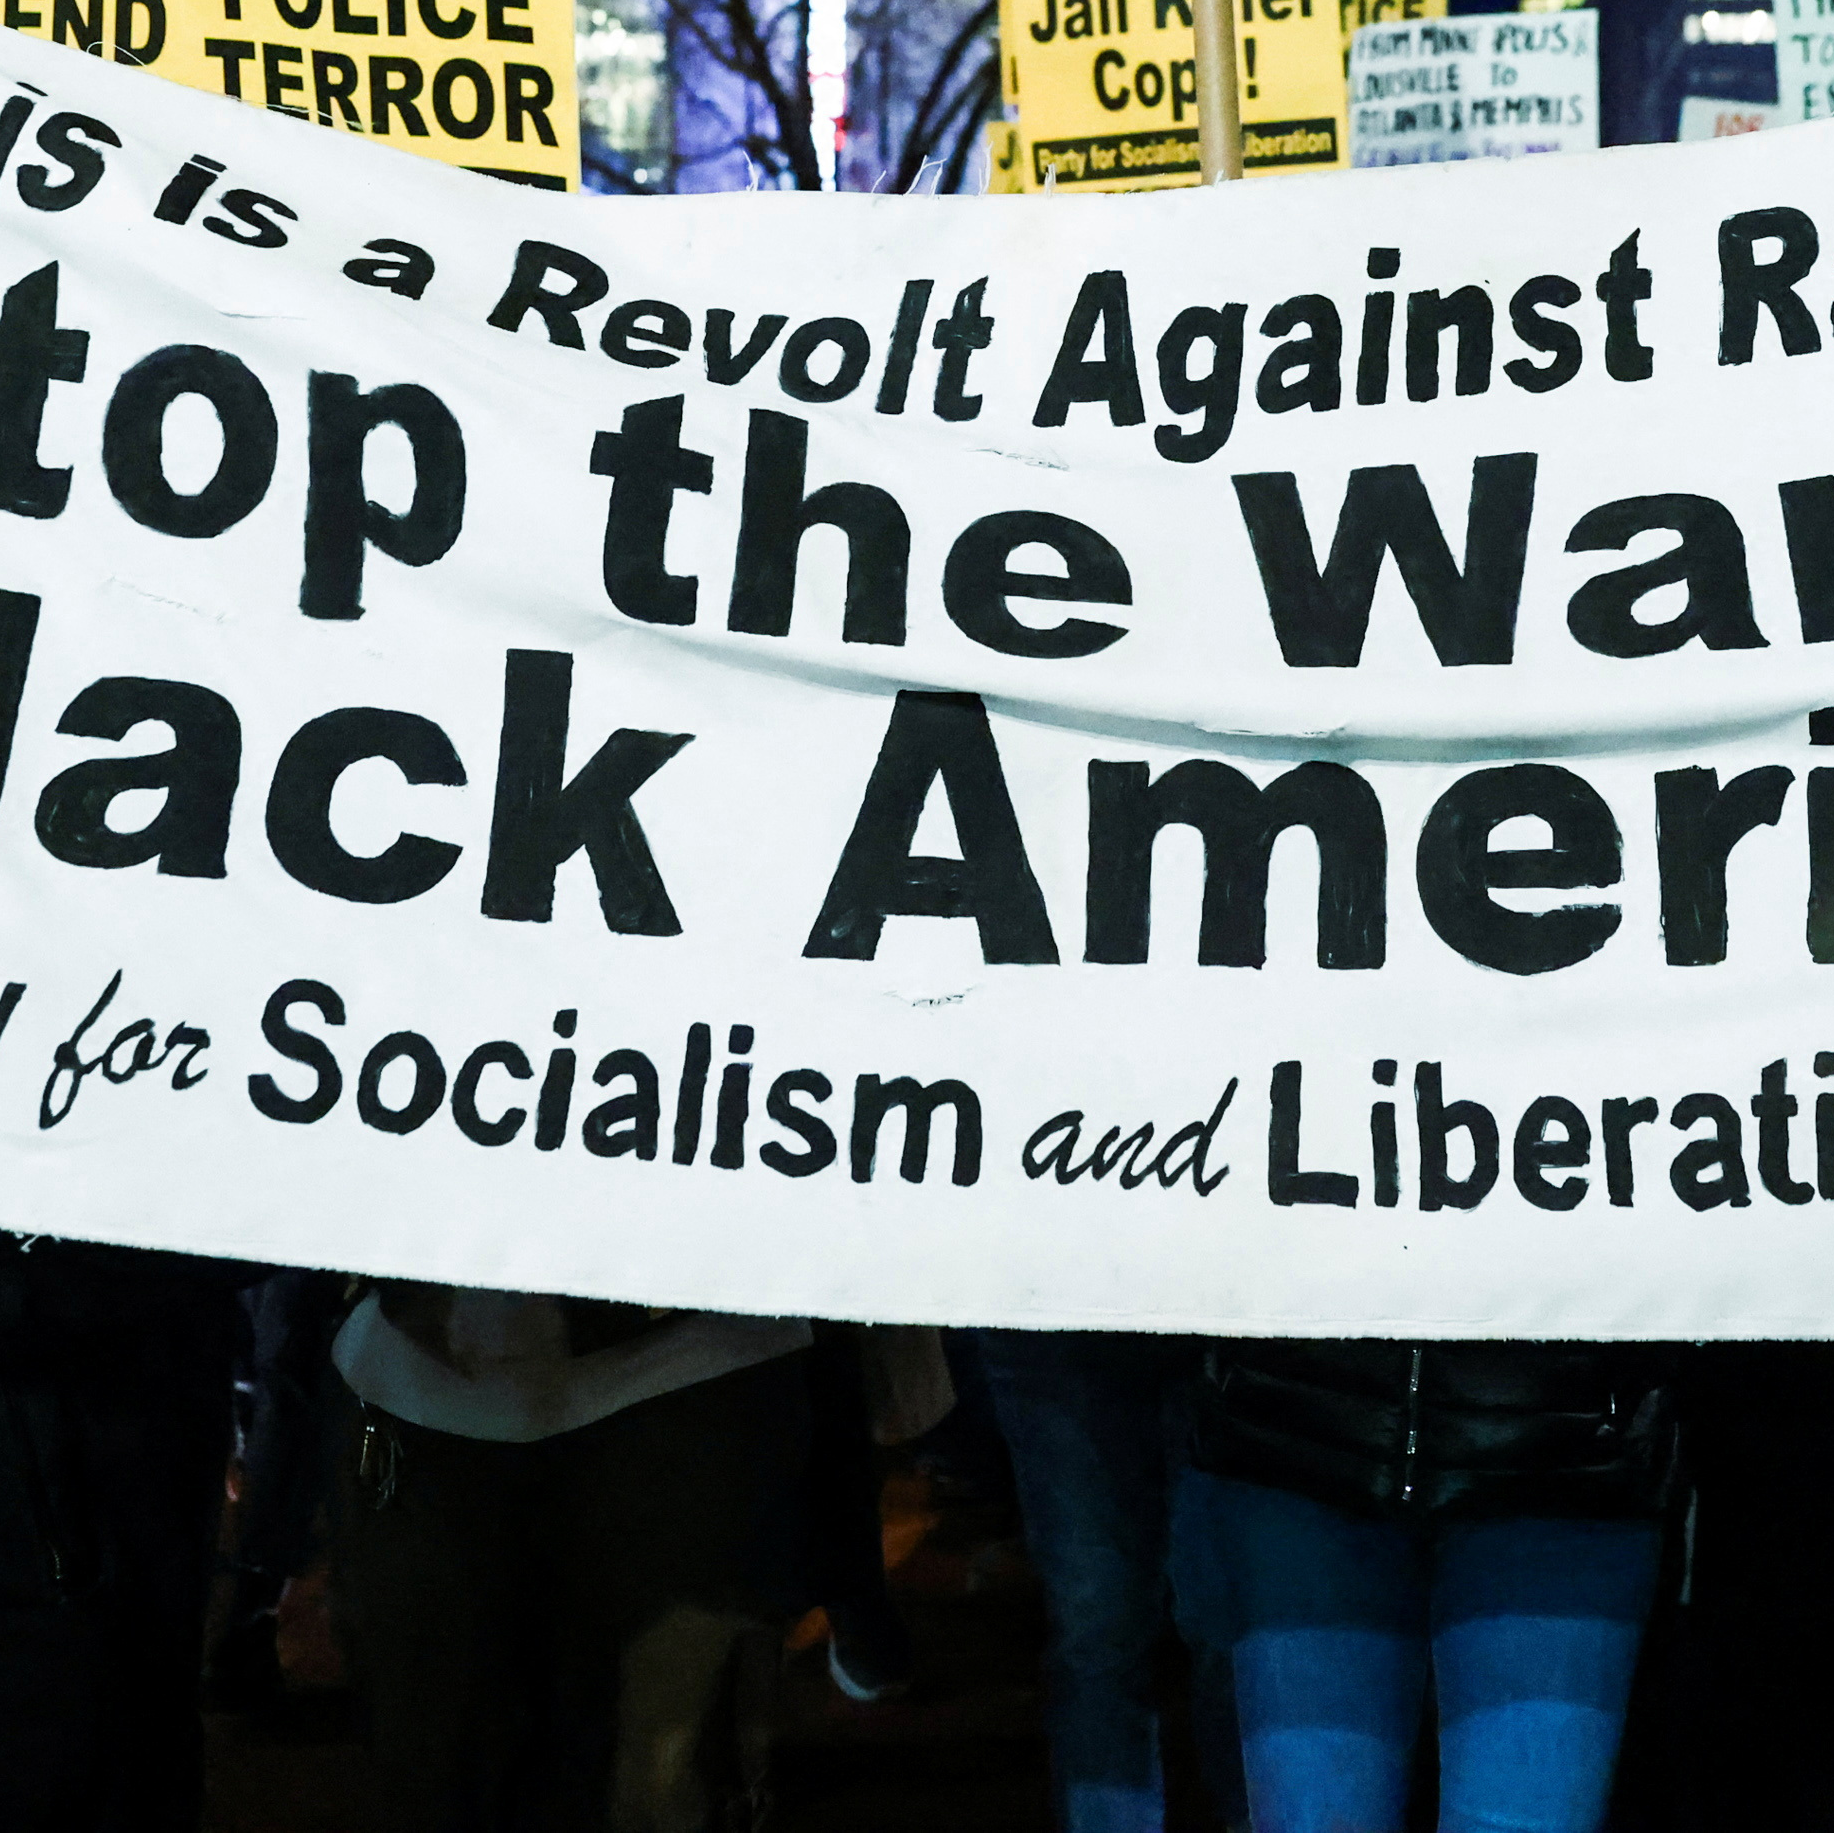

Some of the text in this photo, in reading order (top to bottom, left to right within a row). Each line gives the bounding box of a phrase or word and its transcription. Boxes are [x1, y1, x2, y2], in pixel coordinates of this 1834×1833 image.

[205, 38, 558, 147] TERROR
[1090, 144, 1116, 170] for
[1094, 38, 1259, 122] Cop!
[154, 154, 298, 248] is
[343, 239, 435, 300] a
[486, 240, 994, 422] Revolt
[1032, 228, 1654, 463] Against
[590, 394, 1132, 659] the
[39, 969, 210, 1129] for
[248, 979, 982, 1187] Socialism
[1022, 1077, 1238, 1197] and
